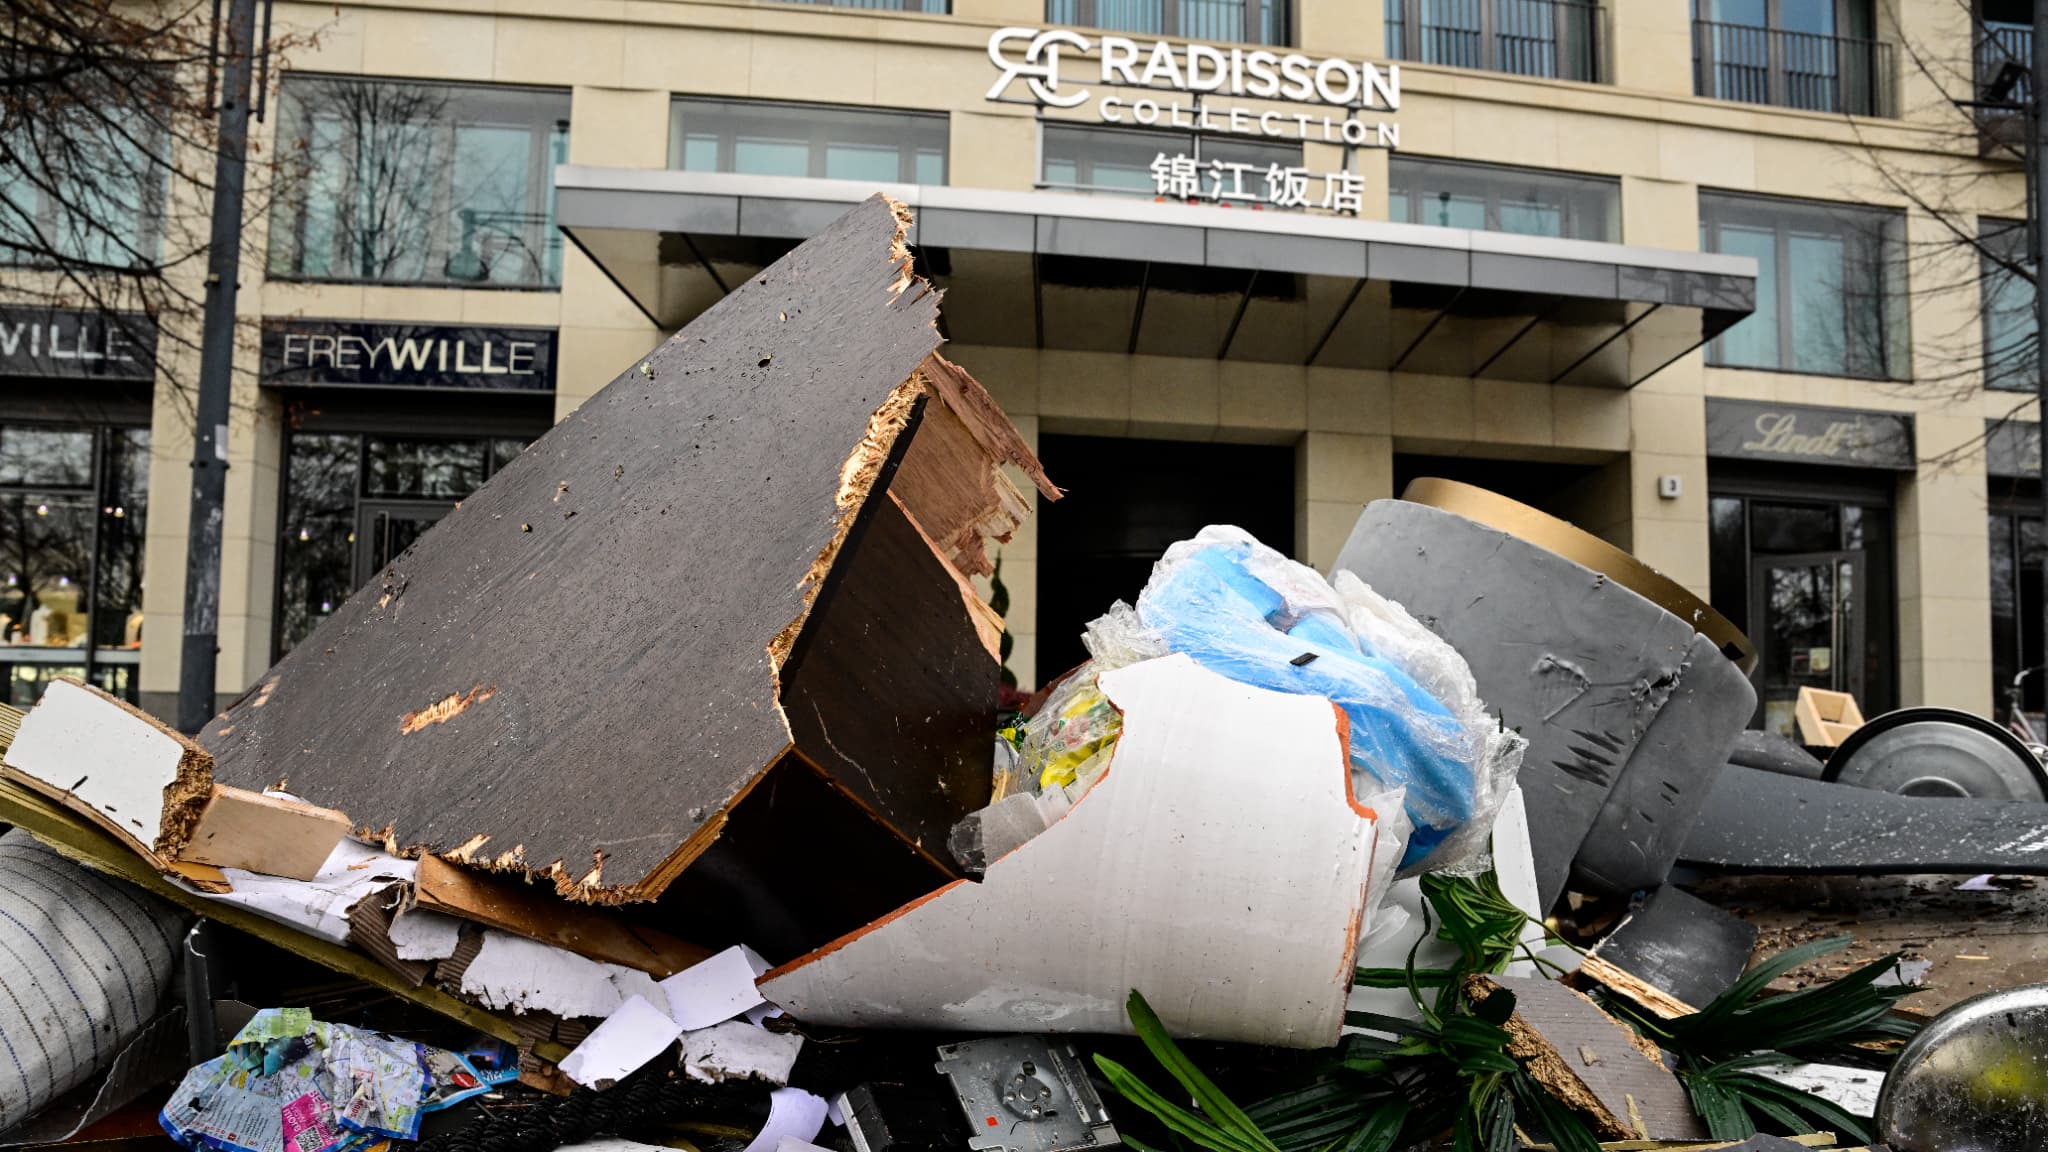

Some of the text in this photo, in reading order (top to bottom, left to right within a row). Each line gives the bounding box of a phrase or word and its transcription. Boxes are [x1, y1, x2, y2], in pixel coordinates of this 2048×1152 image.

[1101, 36, 1401, 112] RADISSON
[1099, 96, 1401, 147] COLLECTION
[1150, 152, 1365, 213] 锦江饭店
[283, 333, 537, 376] FREYWILLE
[1743, 412, 1851, 457] Lindt
[282, 1108, 302, 1132] more
